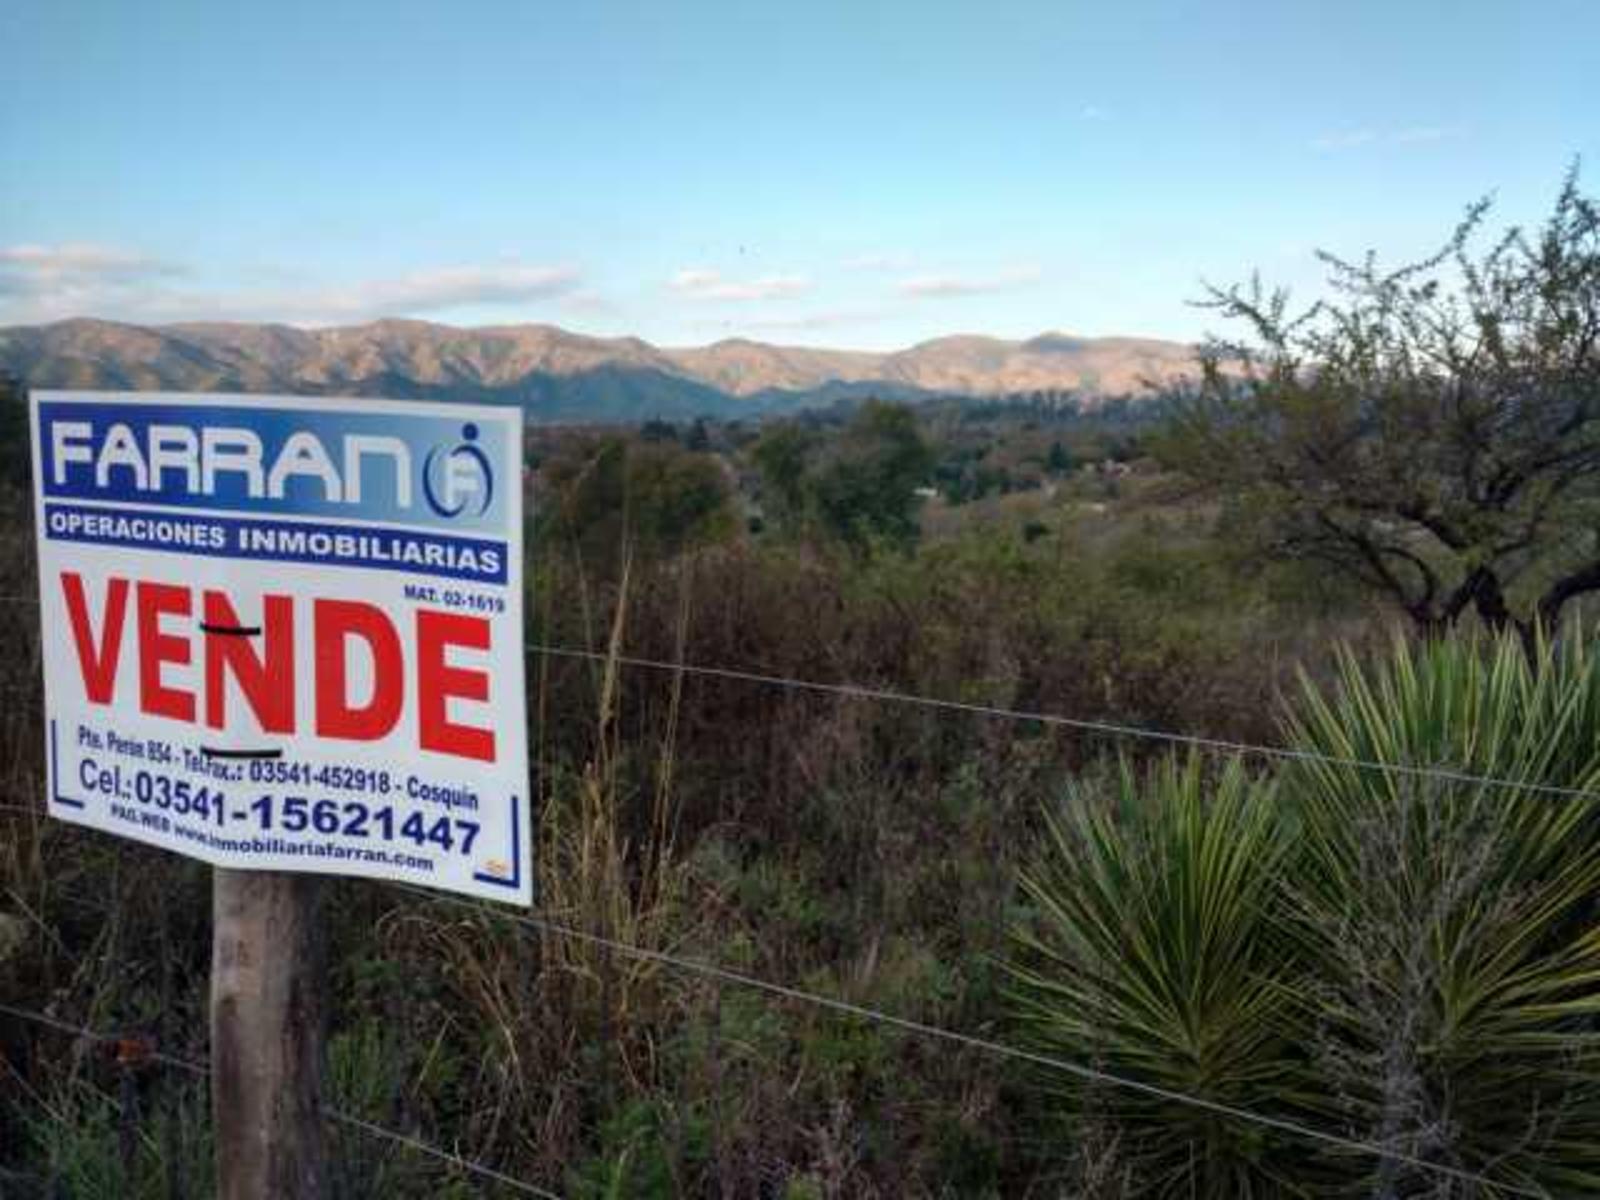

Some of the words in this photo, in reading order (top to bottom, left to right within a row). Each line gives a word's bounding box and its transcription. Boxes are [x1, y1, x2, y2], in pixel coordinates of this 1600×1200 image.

[51, 511, 226, 549] OPERACIONES
[239, 528, 501, 574] INMOBILIARIAS
[404, 584, 439, 601] MAT.
[60, 571, 496, 763] VENDE
[147, 740, 171, 764] 854
[249, 759, 391, 795] 03541-452918
